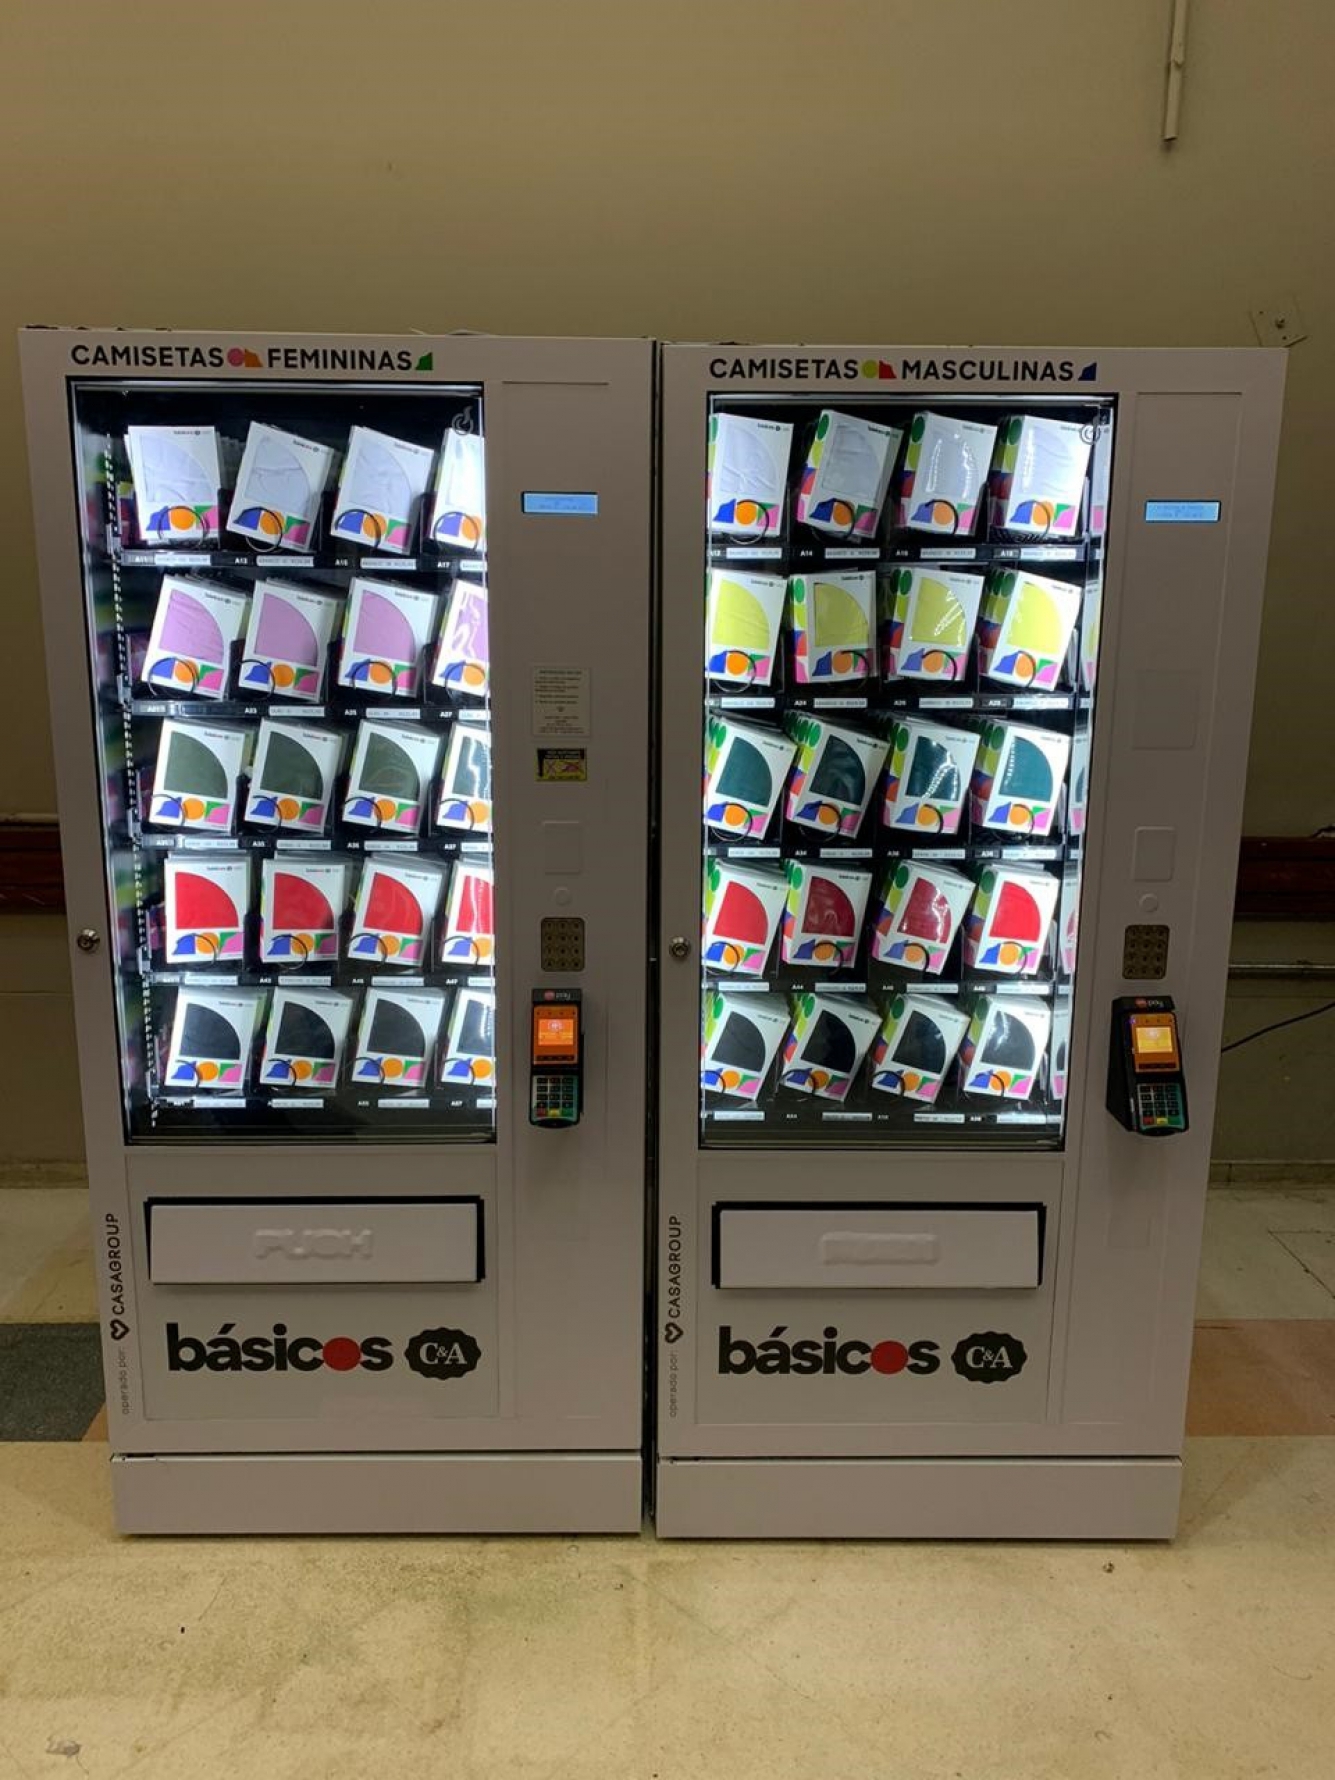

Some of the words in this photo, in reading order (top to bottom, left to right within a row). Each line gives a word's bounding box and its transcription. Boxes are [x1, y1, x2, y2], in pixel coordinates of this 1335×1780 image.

[71, 344, 224, 368] CAMISETAS
[267, 348, 413, 371] FEMININAS
[709, 358, 859, 379] CAMISETAS
[901, 360, 1074, 382] MASCULINAS
[105, 1212, 125, 1316] CASAGROUP
[667, 1215, 682, 1319] CASAGROUP
[166, 1322, 394, 1371] básicos
[418, 1341, 468, 1366] C&A
[718, 1325, 941, 1374] básicos
[965, 1345, 1014, 1369] C&A
